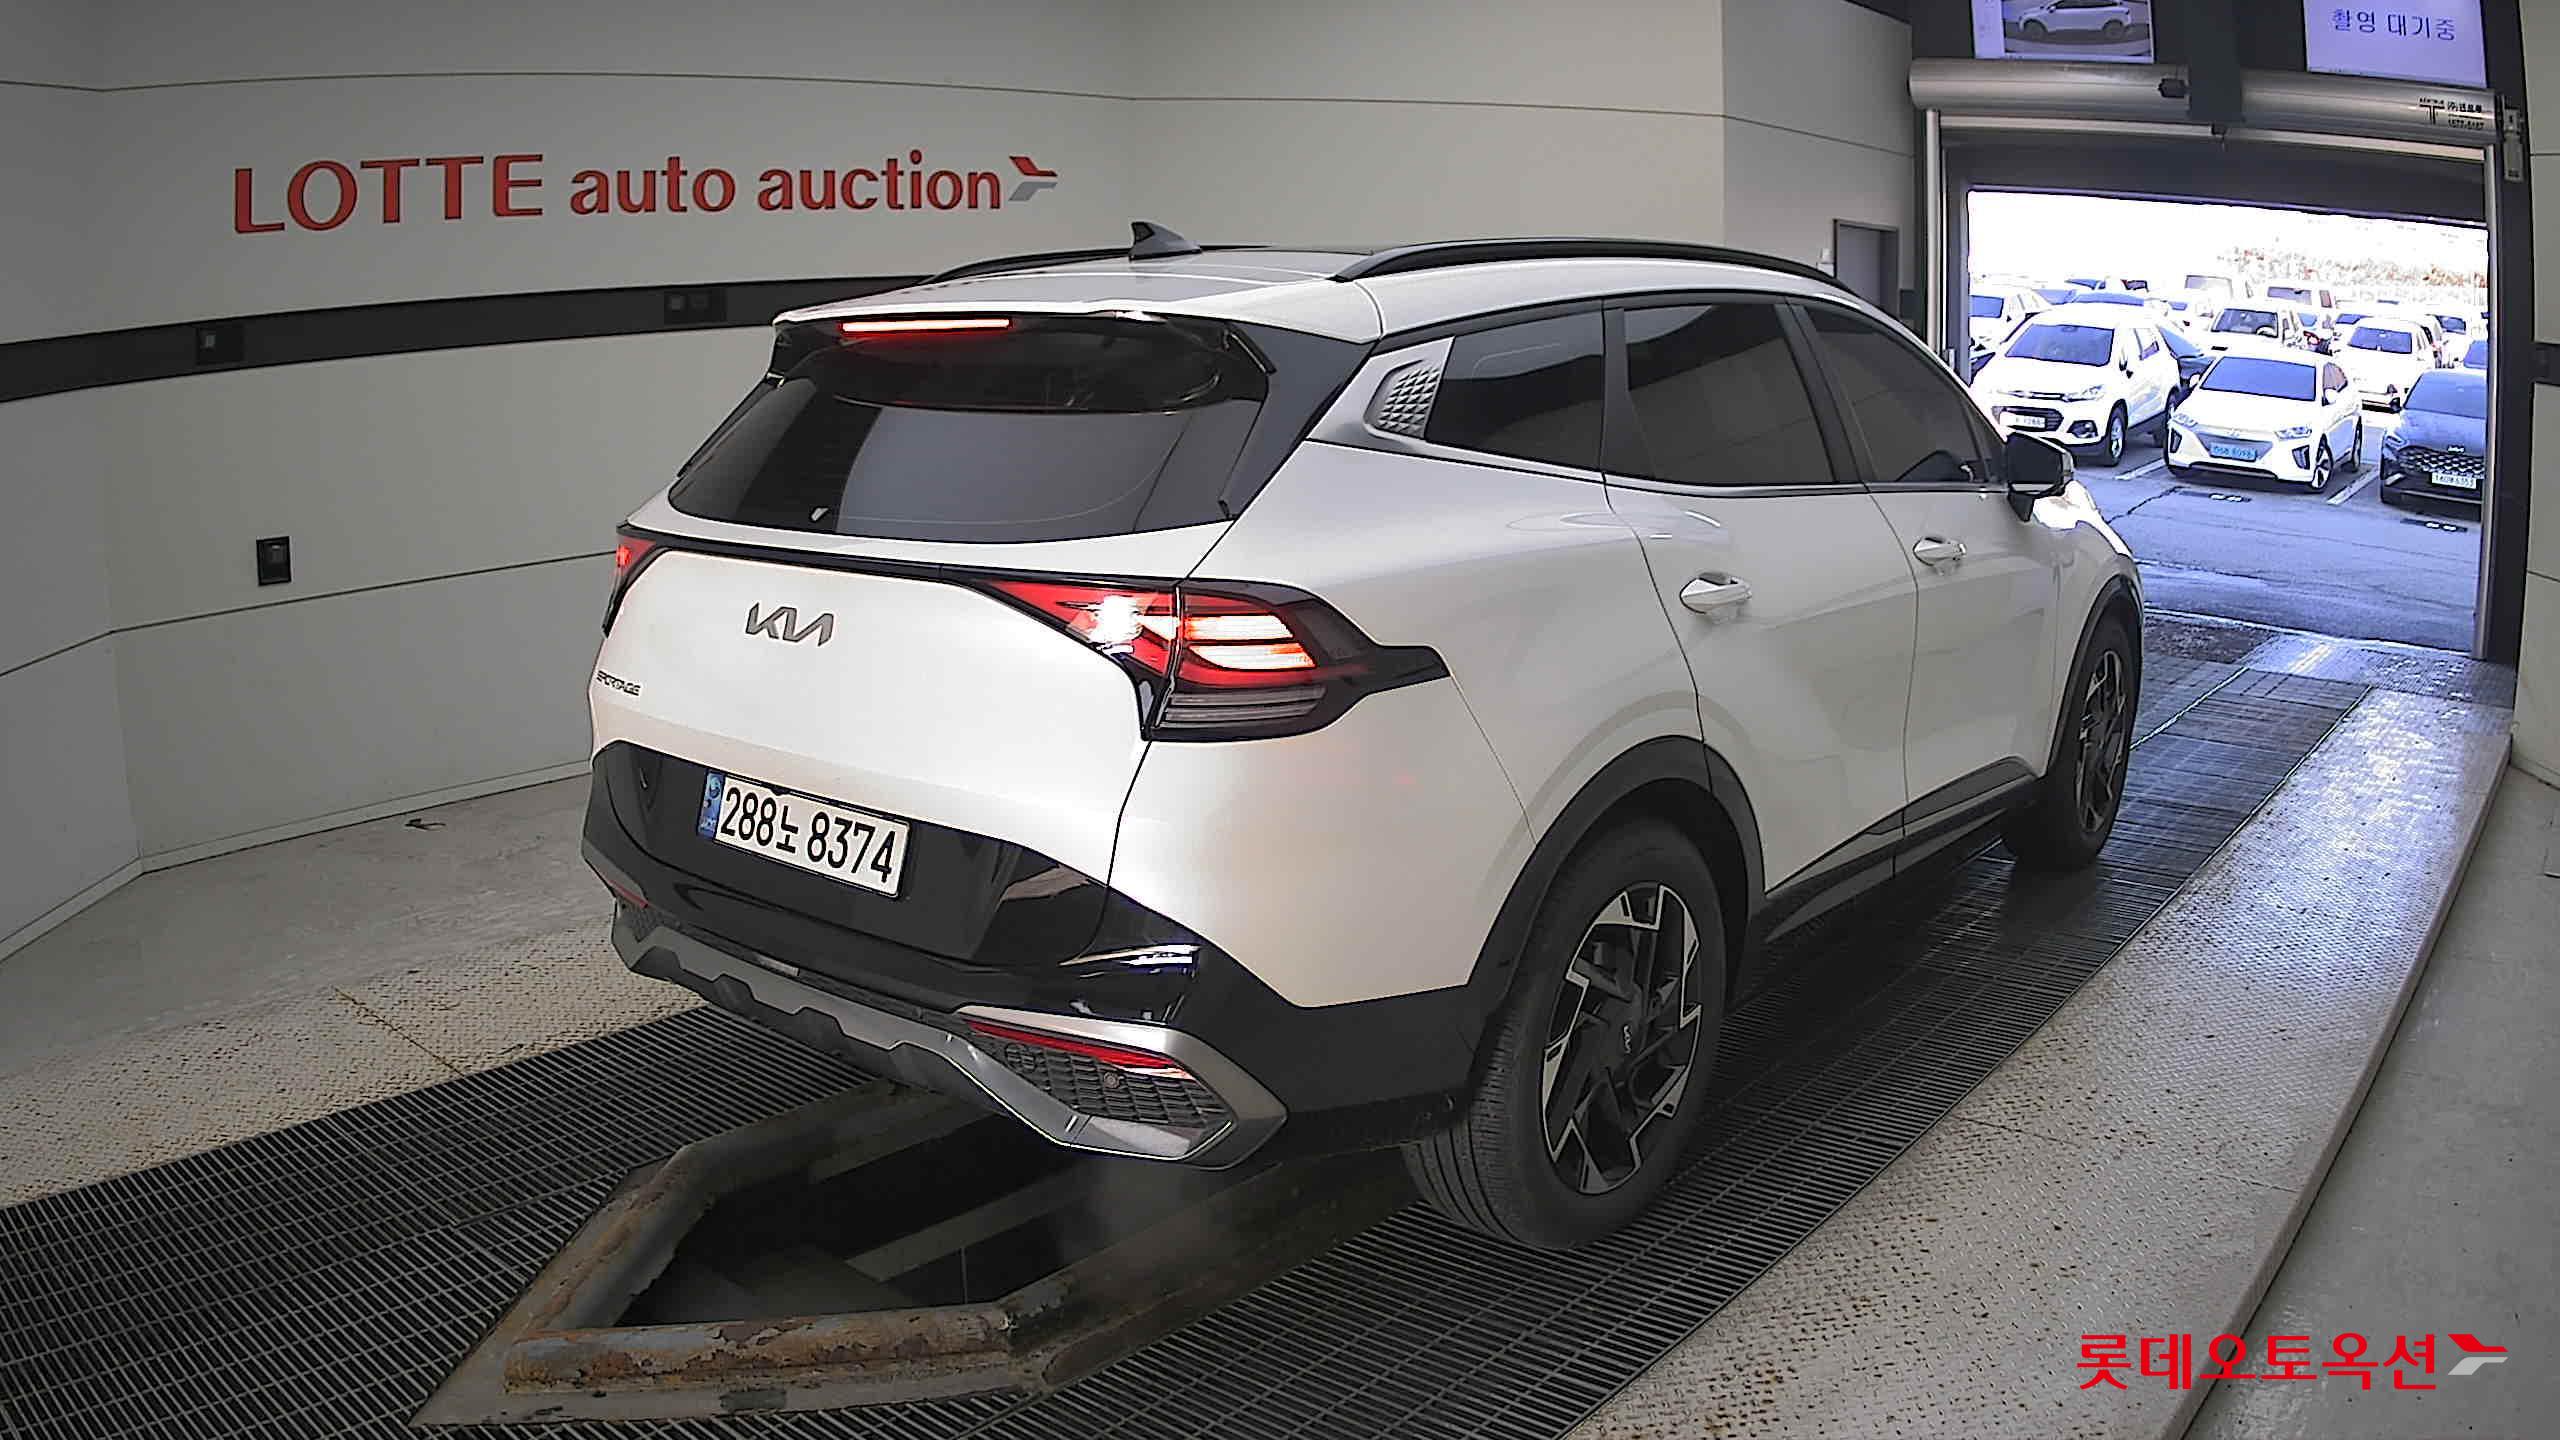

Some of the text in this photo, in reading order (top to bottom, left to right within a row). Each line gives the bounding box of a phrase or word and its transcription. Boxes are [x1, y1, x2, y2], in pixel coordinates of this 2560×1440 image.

[2333, 8, 2456, 41] 촬영 대기중
[234, 150, 1003, 234] LOTTE auto auction
[745, 602, 835, 646] KIA
[720, 786, 898, 884] 288노 8374
